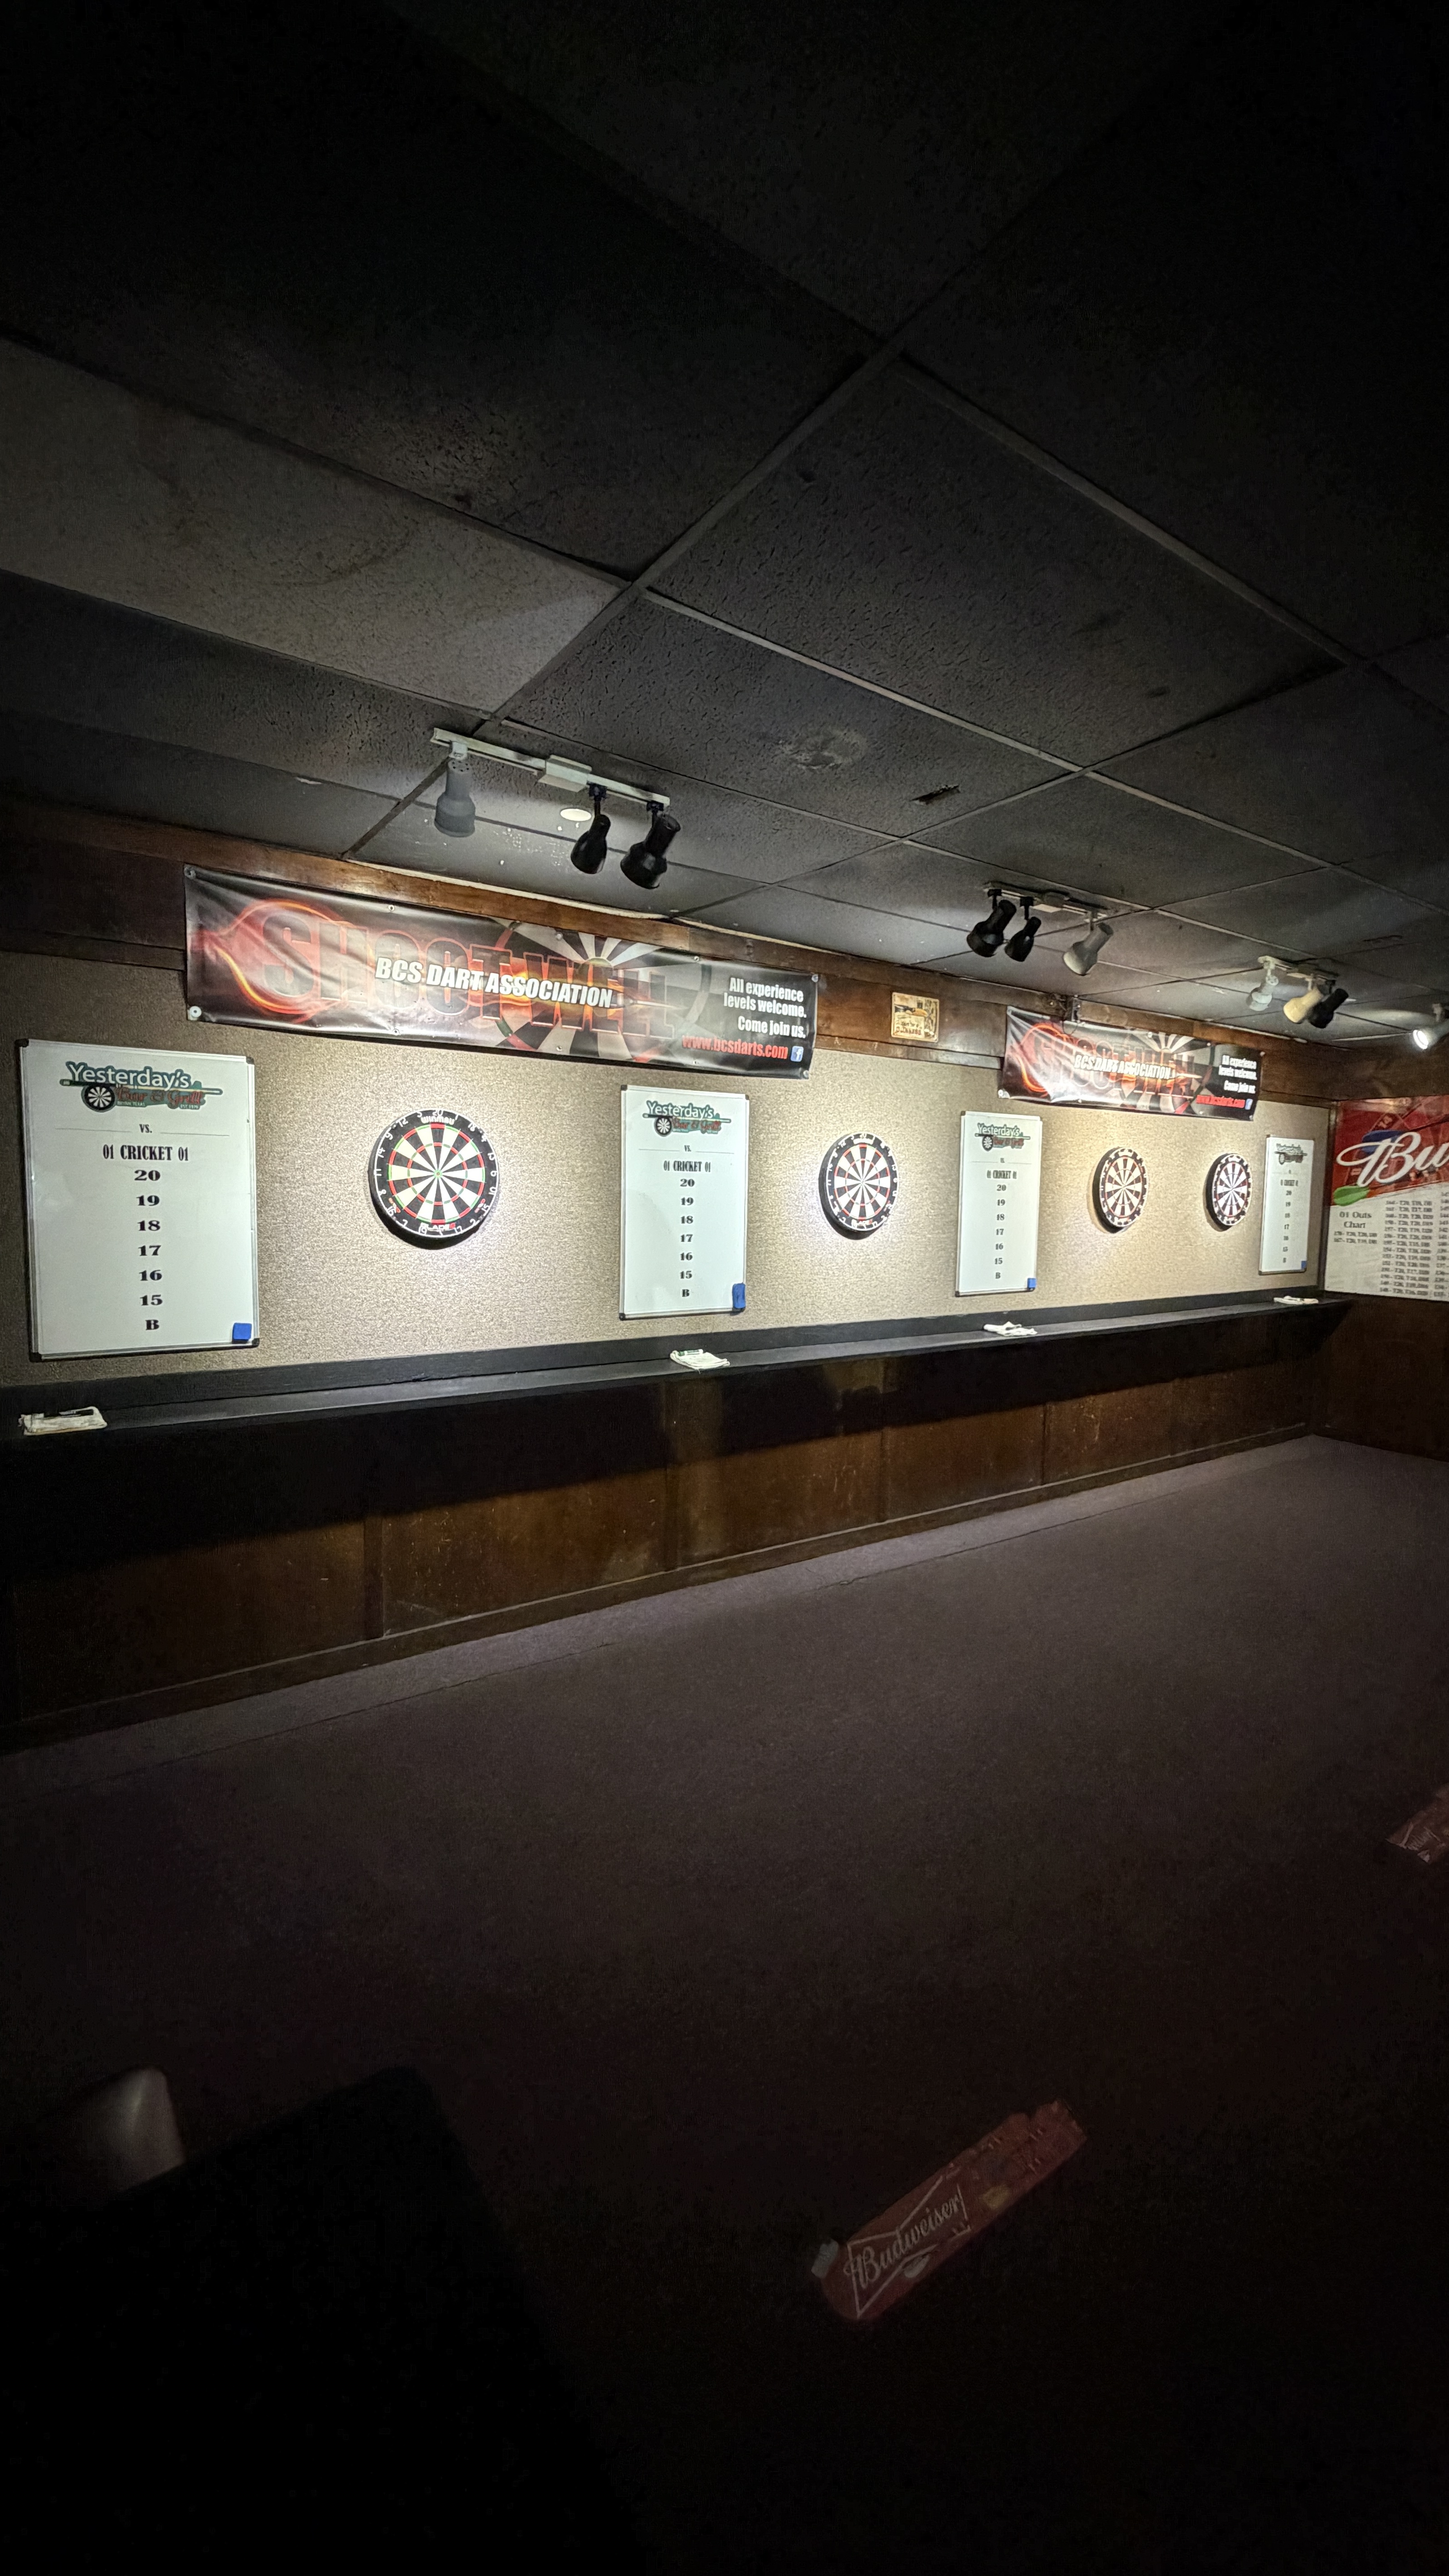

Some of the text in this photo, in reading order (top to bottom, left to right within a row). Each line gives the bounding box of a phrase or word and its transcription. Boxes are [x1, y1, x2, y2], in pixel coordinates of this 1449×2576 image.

[375, 957, 613, 1009] BCS DART ASSOCIATION
[729, 977, 804, 1003] All experience
[723, 993, 807, 1018] levels welcome.
[737, 1016, 806, 1039] Come join us.
[682, 1035, 788, 1059] www.bcsdarts.com
[1074, 1054, 1095, 1070] BCS
[1118, 1060, 1171, 1080] ASSOCIATION
[69, 1064, 189, 1091] Yesterday's
[647, 1101, 713, 1121] Yesterday's
[396, 1118, 409, 1127] 12
[978, 1123, 1020, 1137] Yesterday's
[103, 1144, 189, 1161] 01 CRICKET 01
[663, 1160, 711, 1173] 01 CRICKET 01
[134, 1170, 161, 1181] 20
[680, 1179, 695, 1187] 20
[488, 1187, 497, 1196] 10
[136, 1195, 160, 1206] 19
[681, 1197, 694, 1205] 19
[138, 1220, 161, 1231] 18
[138, 1245, 161, 1256] 17
[681, 1252, 693, 1260] 16
[139, 1270, 162, 1281] 16
[680, 1271, 692, 1279] 15
[140, 1295, 162, 1306] 15
[145, 1320, 159, 1330] B
[843, 2191, 961, 2289] Budweiser
